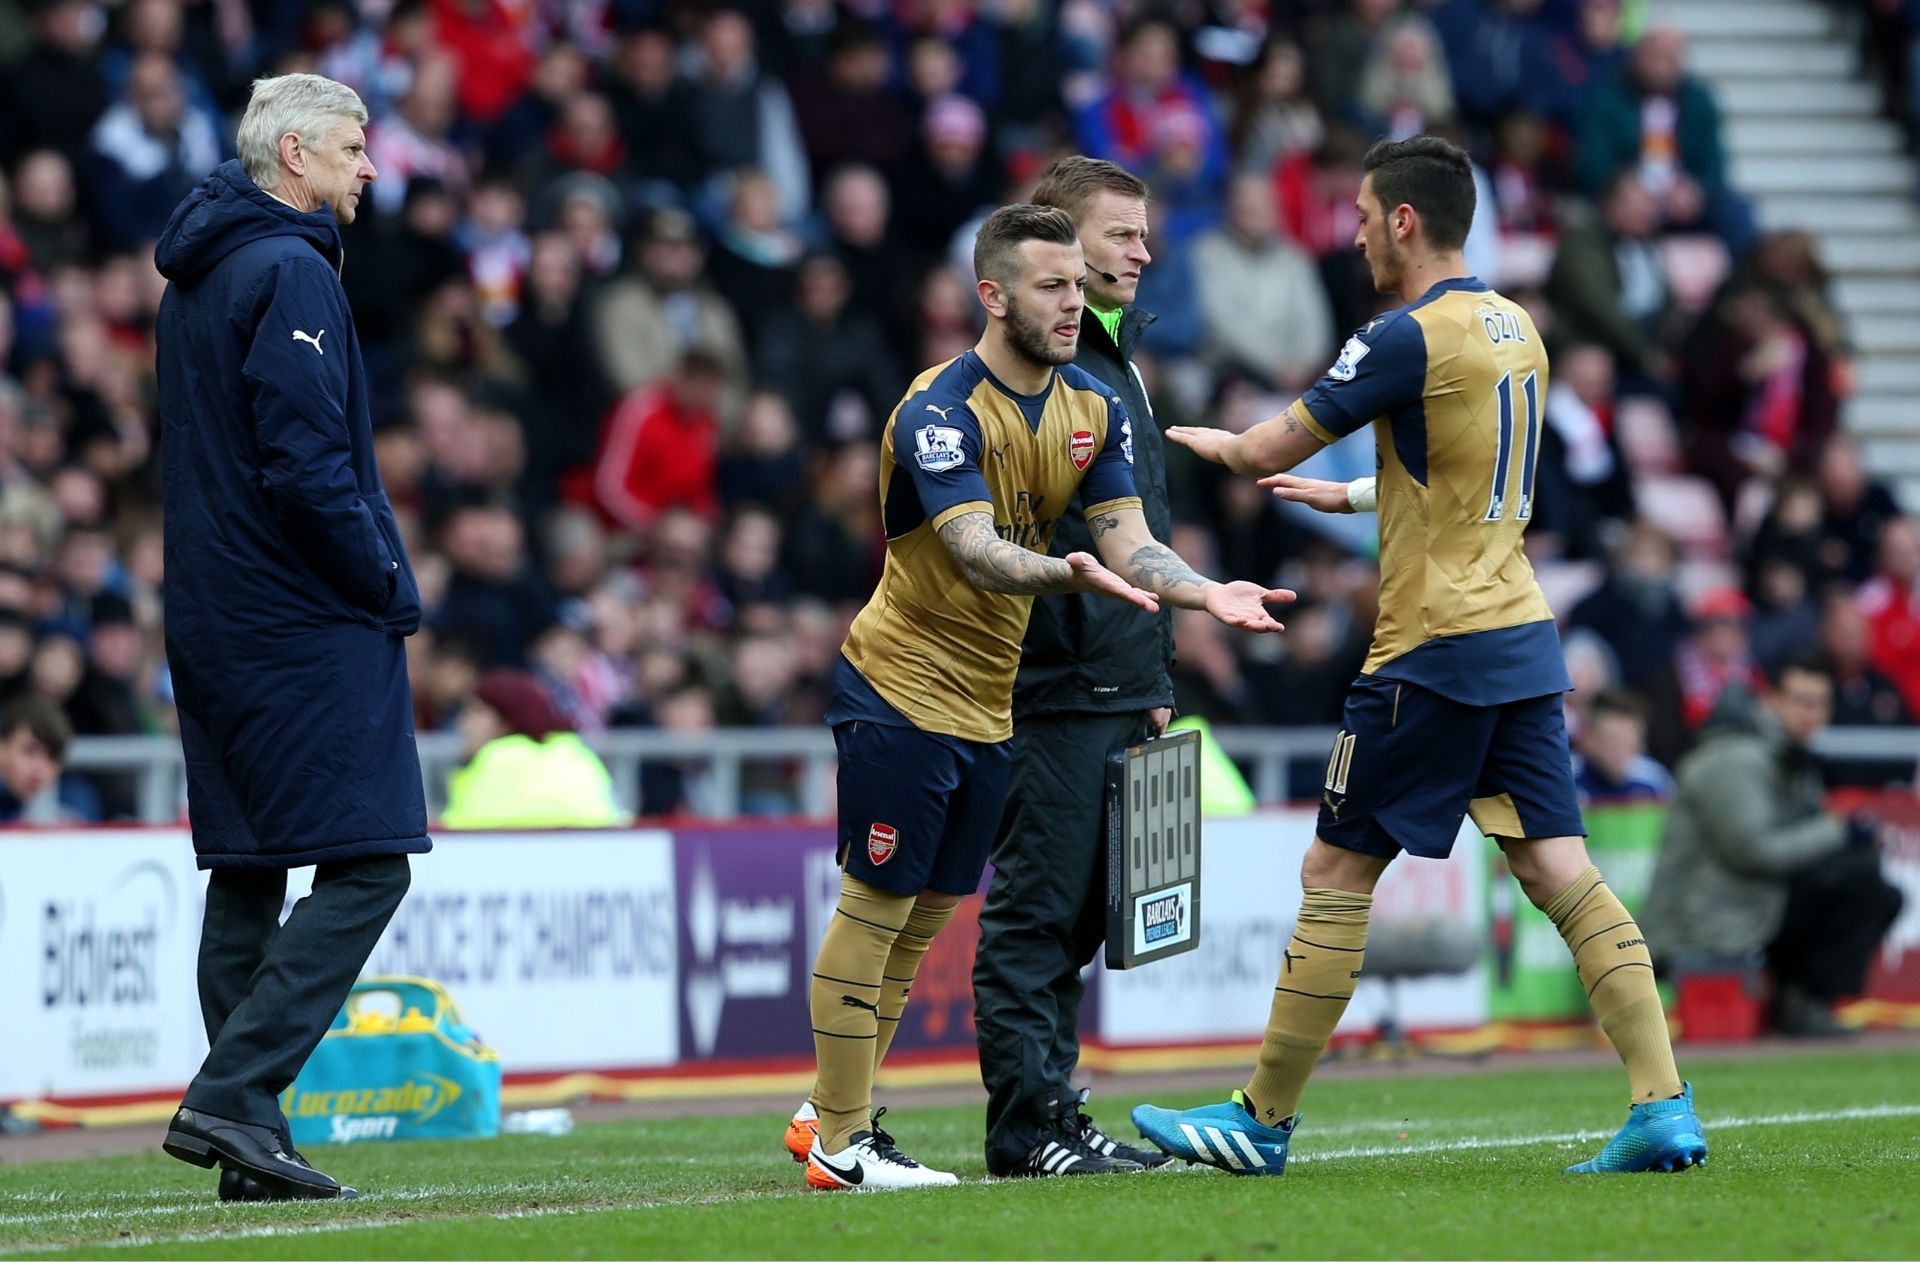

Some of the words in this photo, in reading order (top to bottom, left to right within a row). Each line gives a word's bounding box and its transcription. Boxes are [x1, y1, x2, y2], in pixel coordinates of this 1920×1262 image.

[1484, 369, 1538, 521] 11
[1325, 730, 1356, 794] 11
[870, 828, 895, 841] Arsenal
[1146, 896, 1176, 927] BARCLAYS
[283, 1081, 433, 1118] Lucozade
[330, 1114, 398, 1144] Sport
